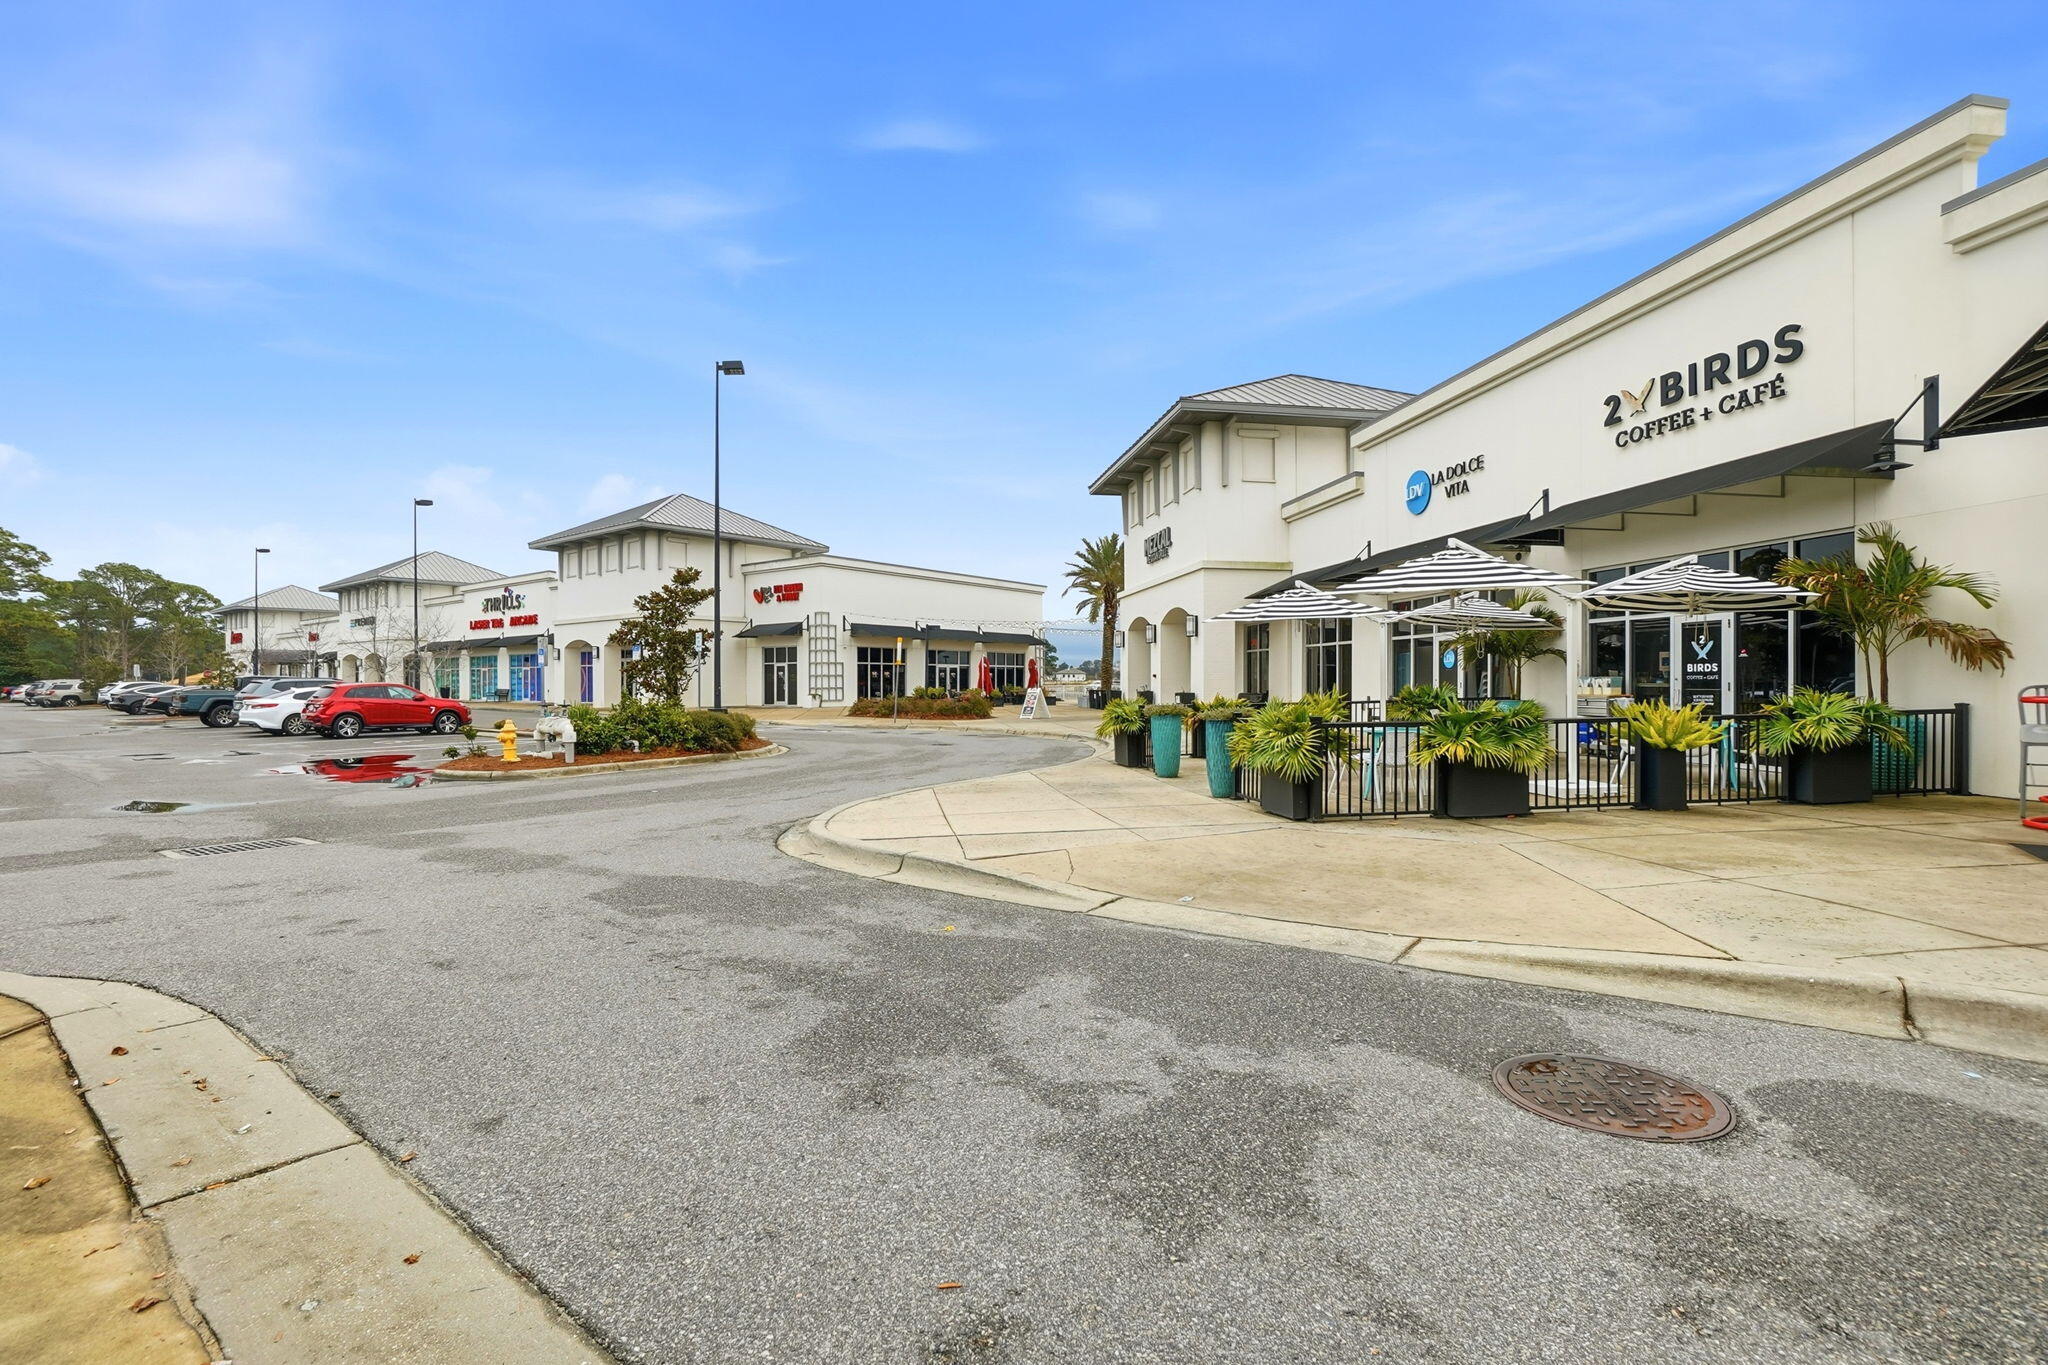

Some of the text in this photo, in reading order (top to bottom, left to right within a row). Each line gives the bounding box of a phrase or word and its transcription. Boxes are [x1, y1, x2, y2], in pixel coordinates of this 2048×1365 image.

[1603, 324, 1804, 427] 2 BIRDS
[1615, 407, 1695, 448] COFFEE
[1718, 372, 1786, 414] CAFÉ
[1431, 454, 1485, 486] LA DOLCE
[1444, 480, 1470, 498] VITA
[1699, 635, 1706, 644] 2
[1686, 663, 1718, 672] BIRDS
